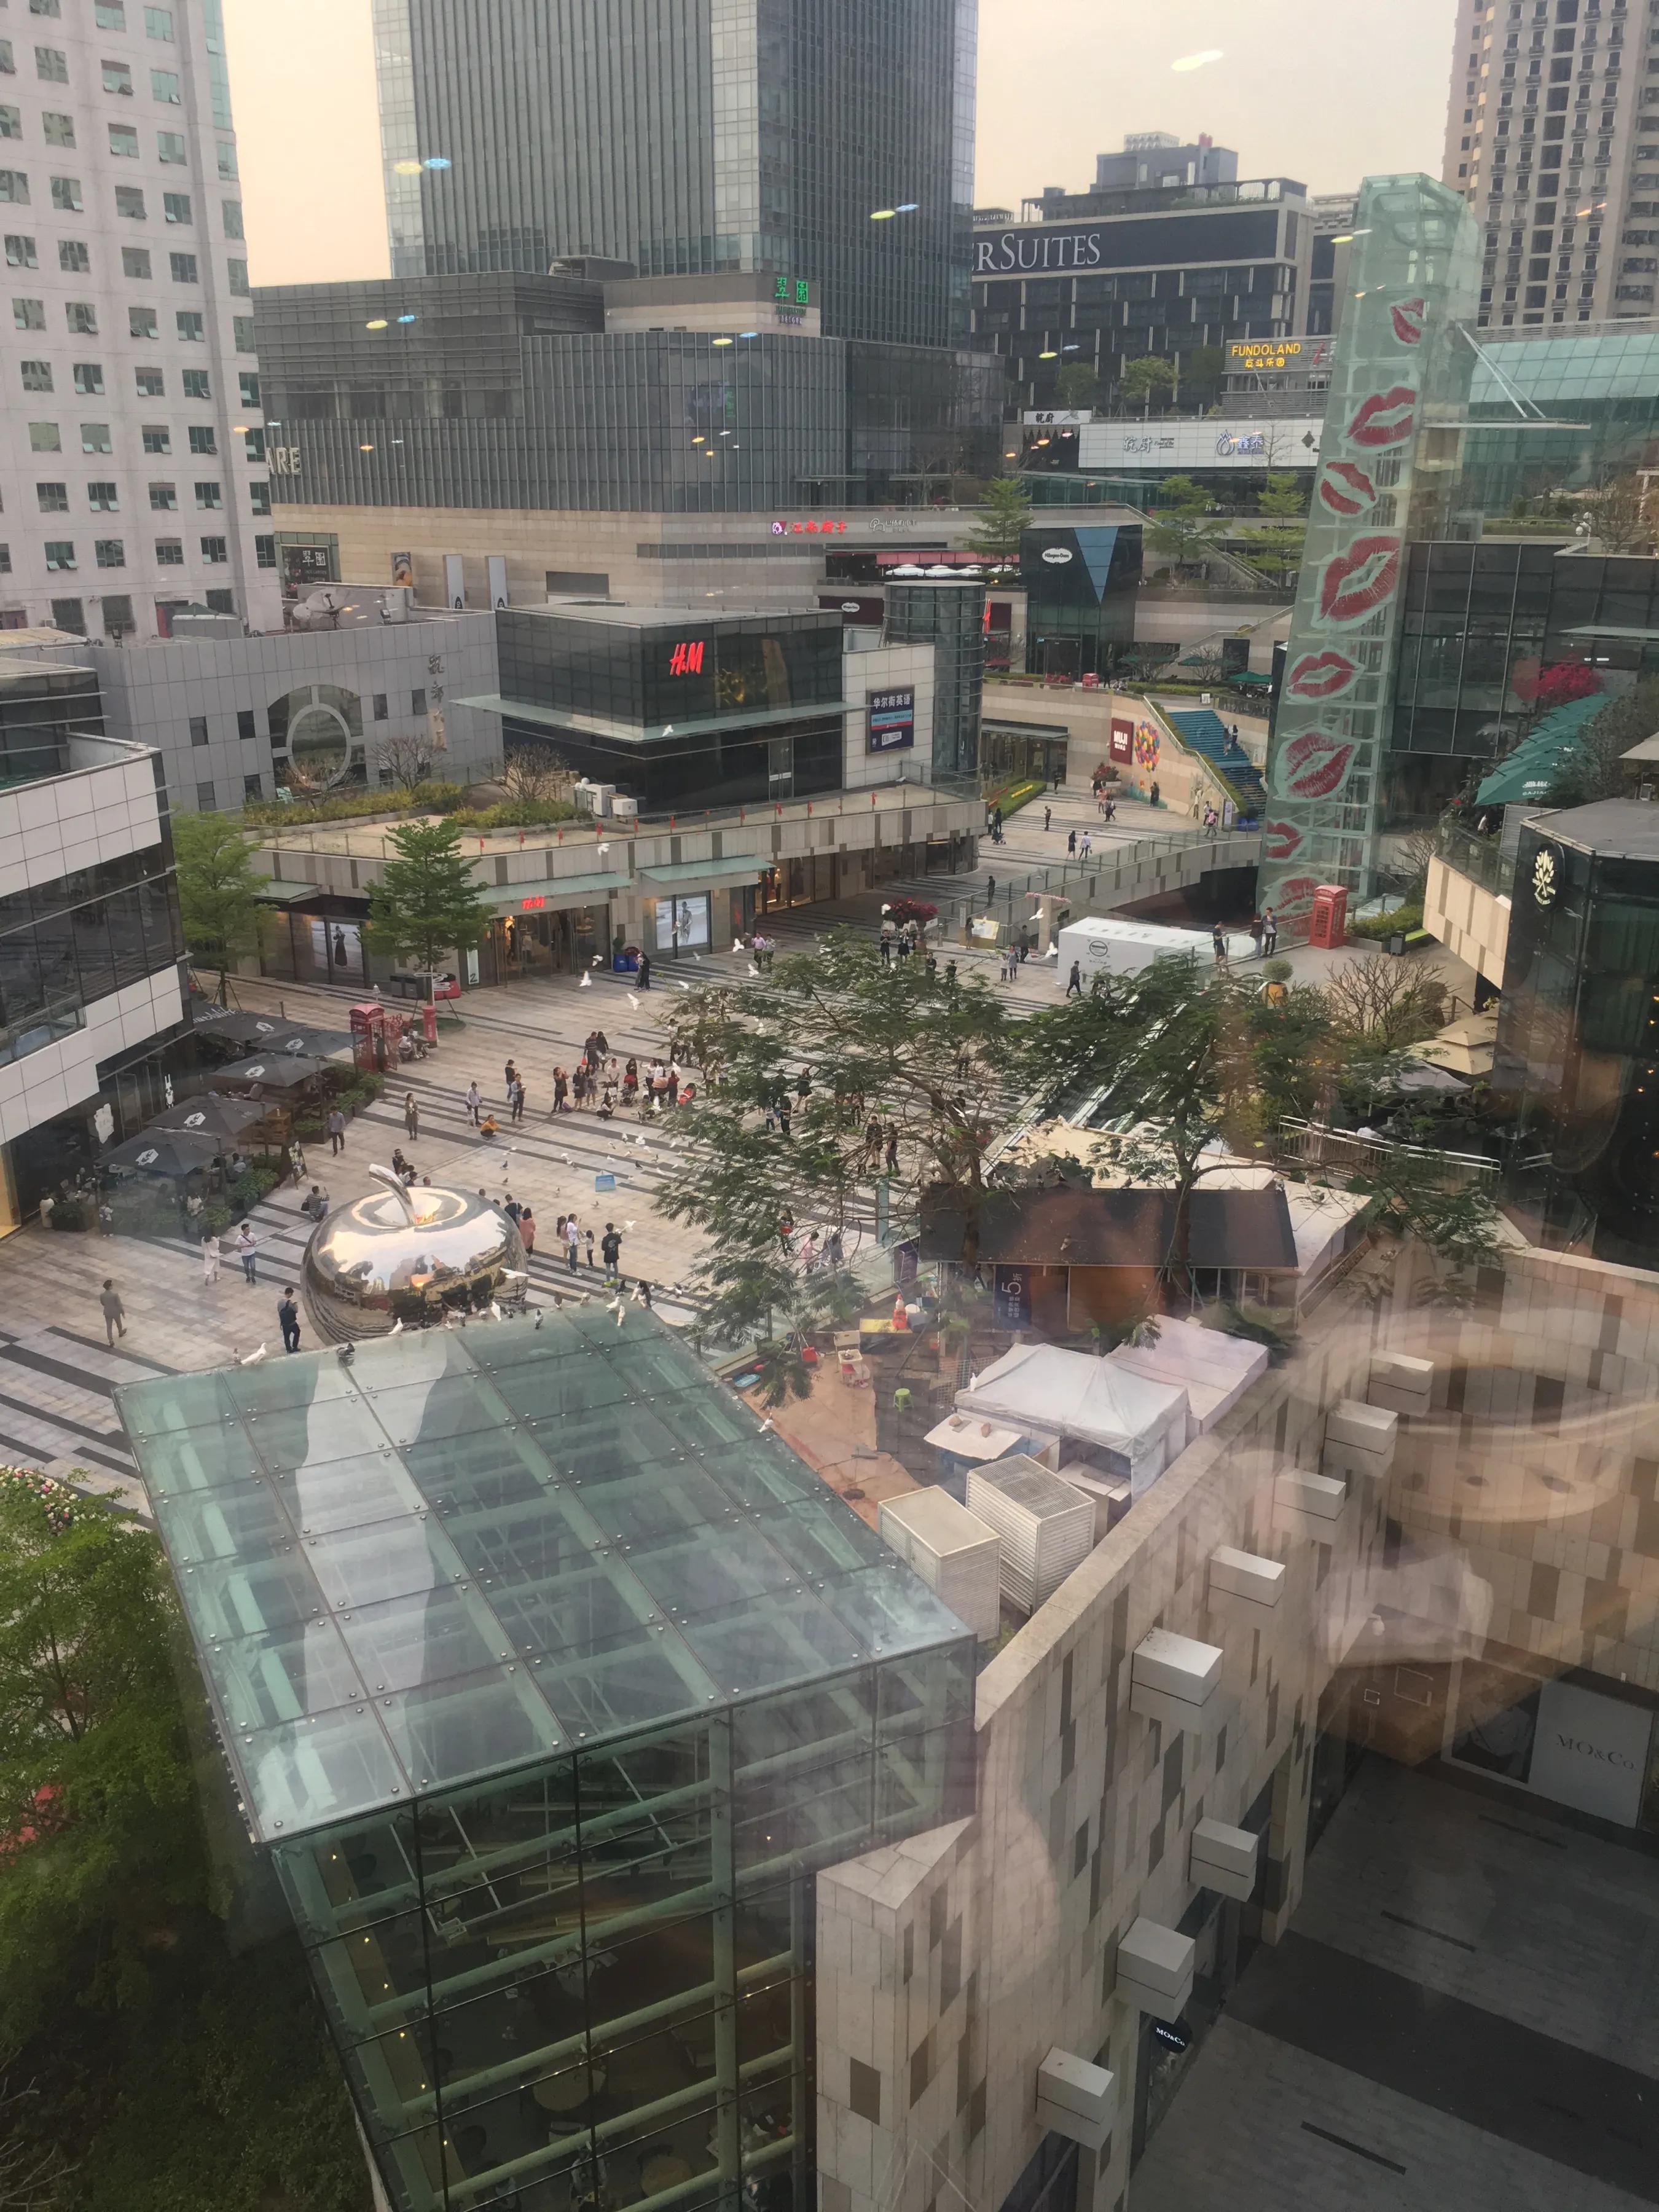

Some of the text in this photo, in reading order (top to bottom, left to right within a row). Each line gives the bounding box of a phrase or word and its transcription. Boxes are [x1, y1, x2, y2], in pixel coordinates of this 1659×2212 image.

[971, 233, 1100, 272] RSUITES
[1231, 343, 1301, 356] FUNDOLAND
[669, 641, 704, 676] H&M
[873, 694, 911, 709] 华尔街英语
[1113, 730, 1128, 745] MUJI
